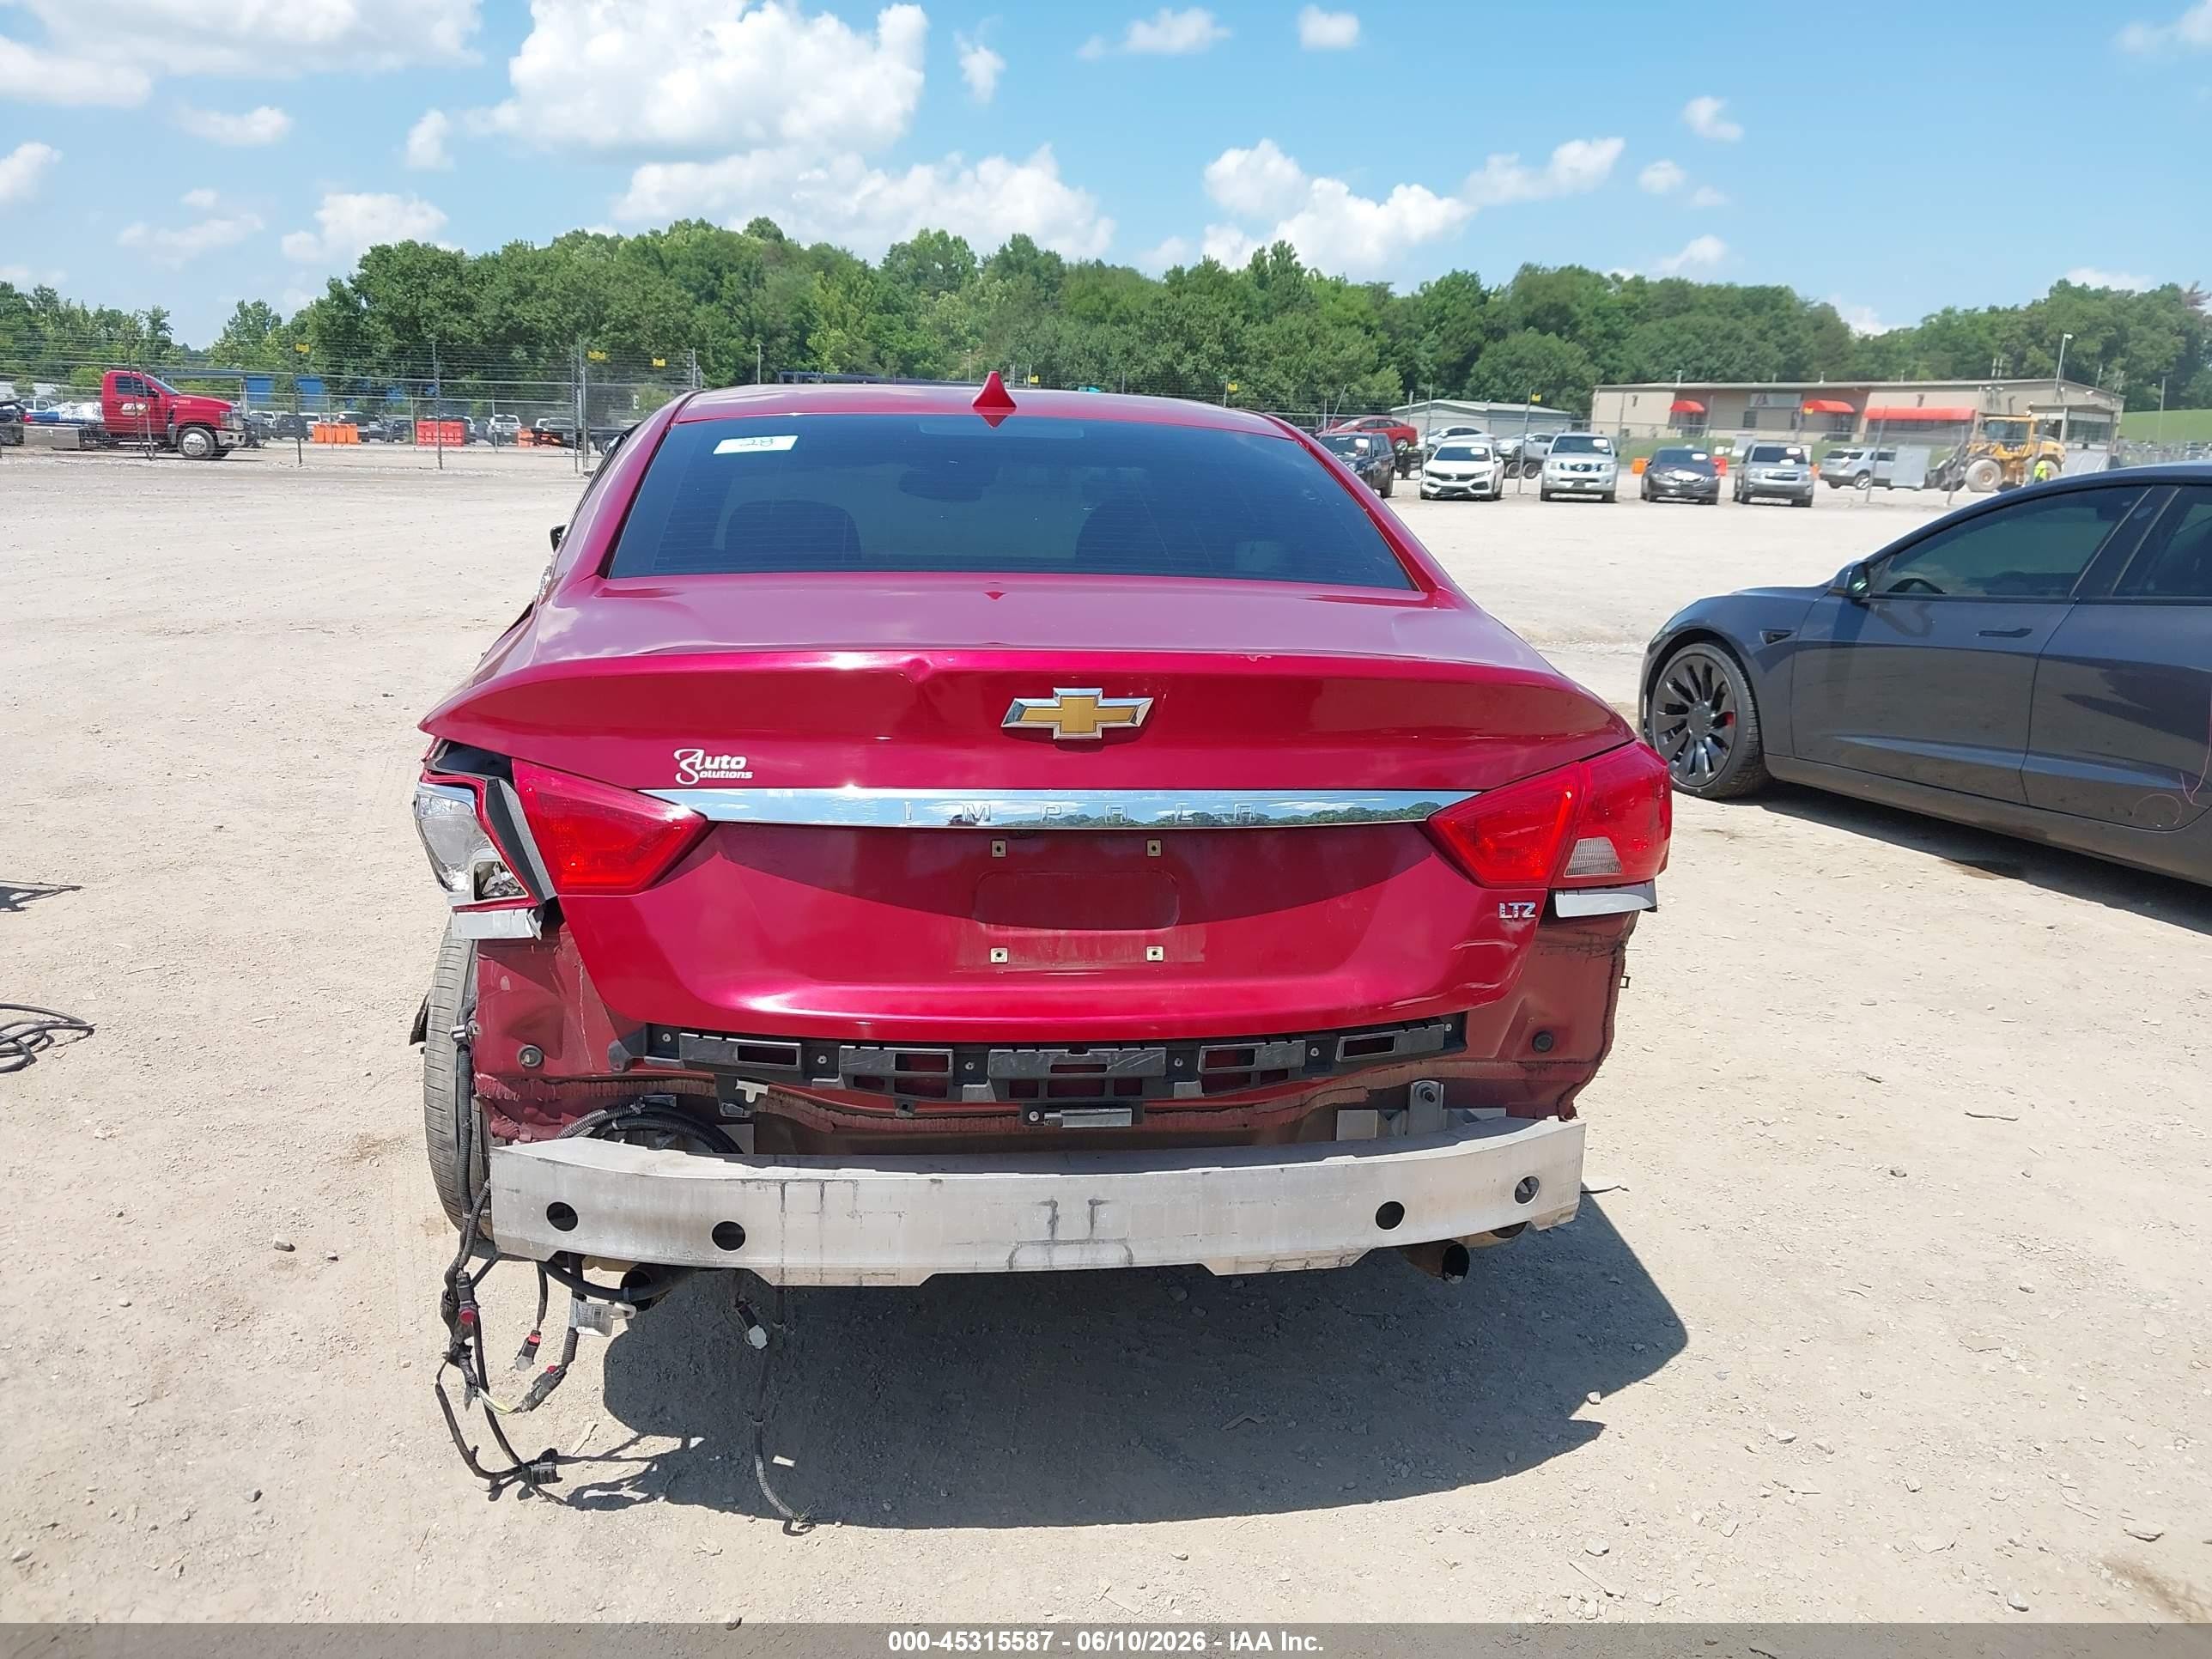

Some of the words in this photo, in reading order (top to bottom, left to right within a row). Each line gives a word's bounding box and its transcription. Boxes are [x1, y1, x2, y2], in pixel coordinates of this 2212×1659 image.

[673, 748, 747, 770] Auto
[675, 761, 754, 785] Solutions
[904, 801, 1258, 824] IMPALA
[1498, 902, 1536, 919] LTZ
